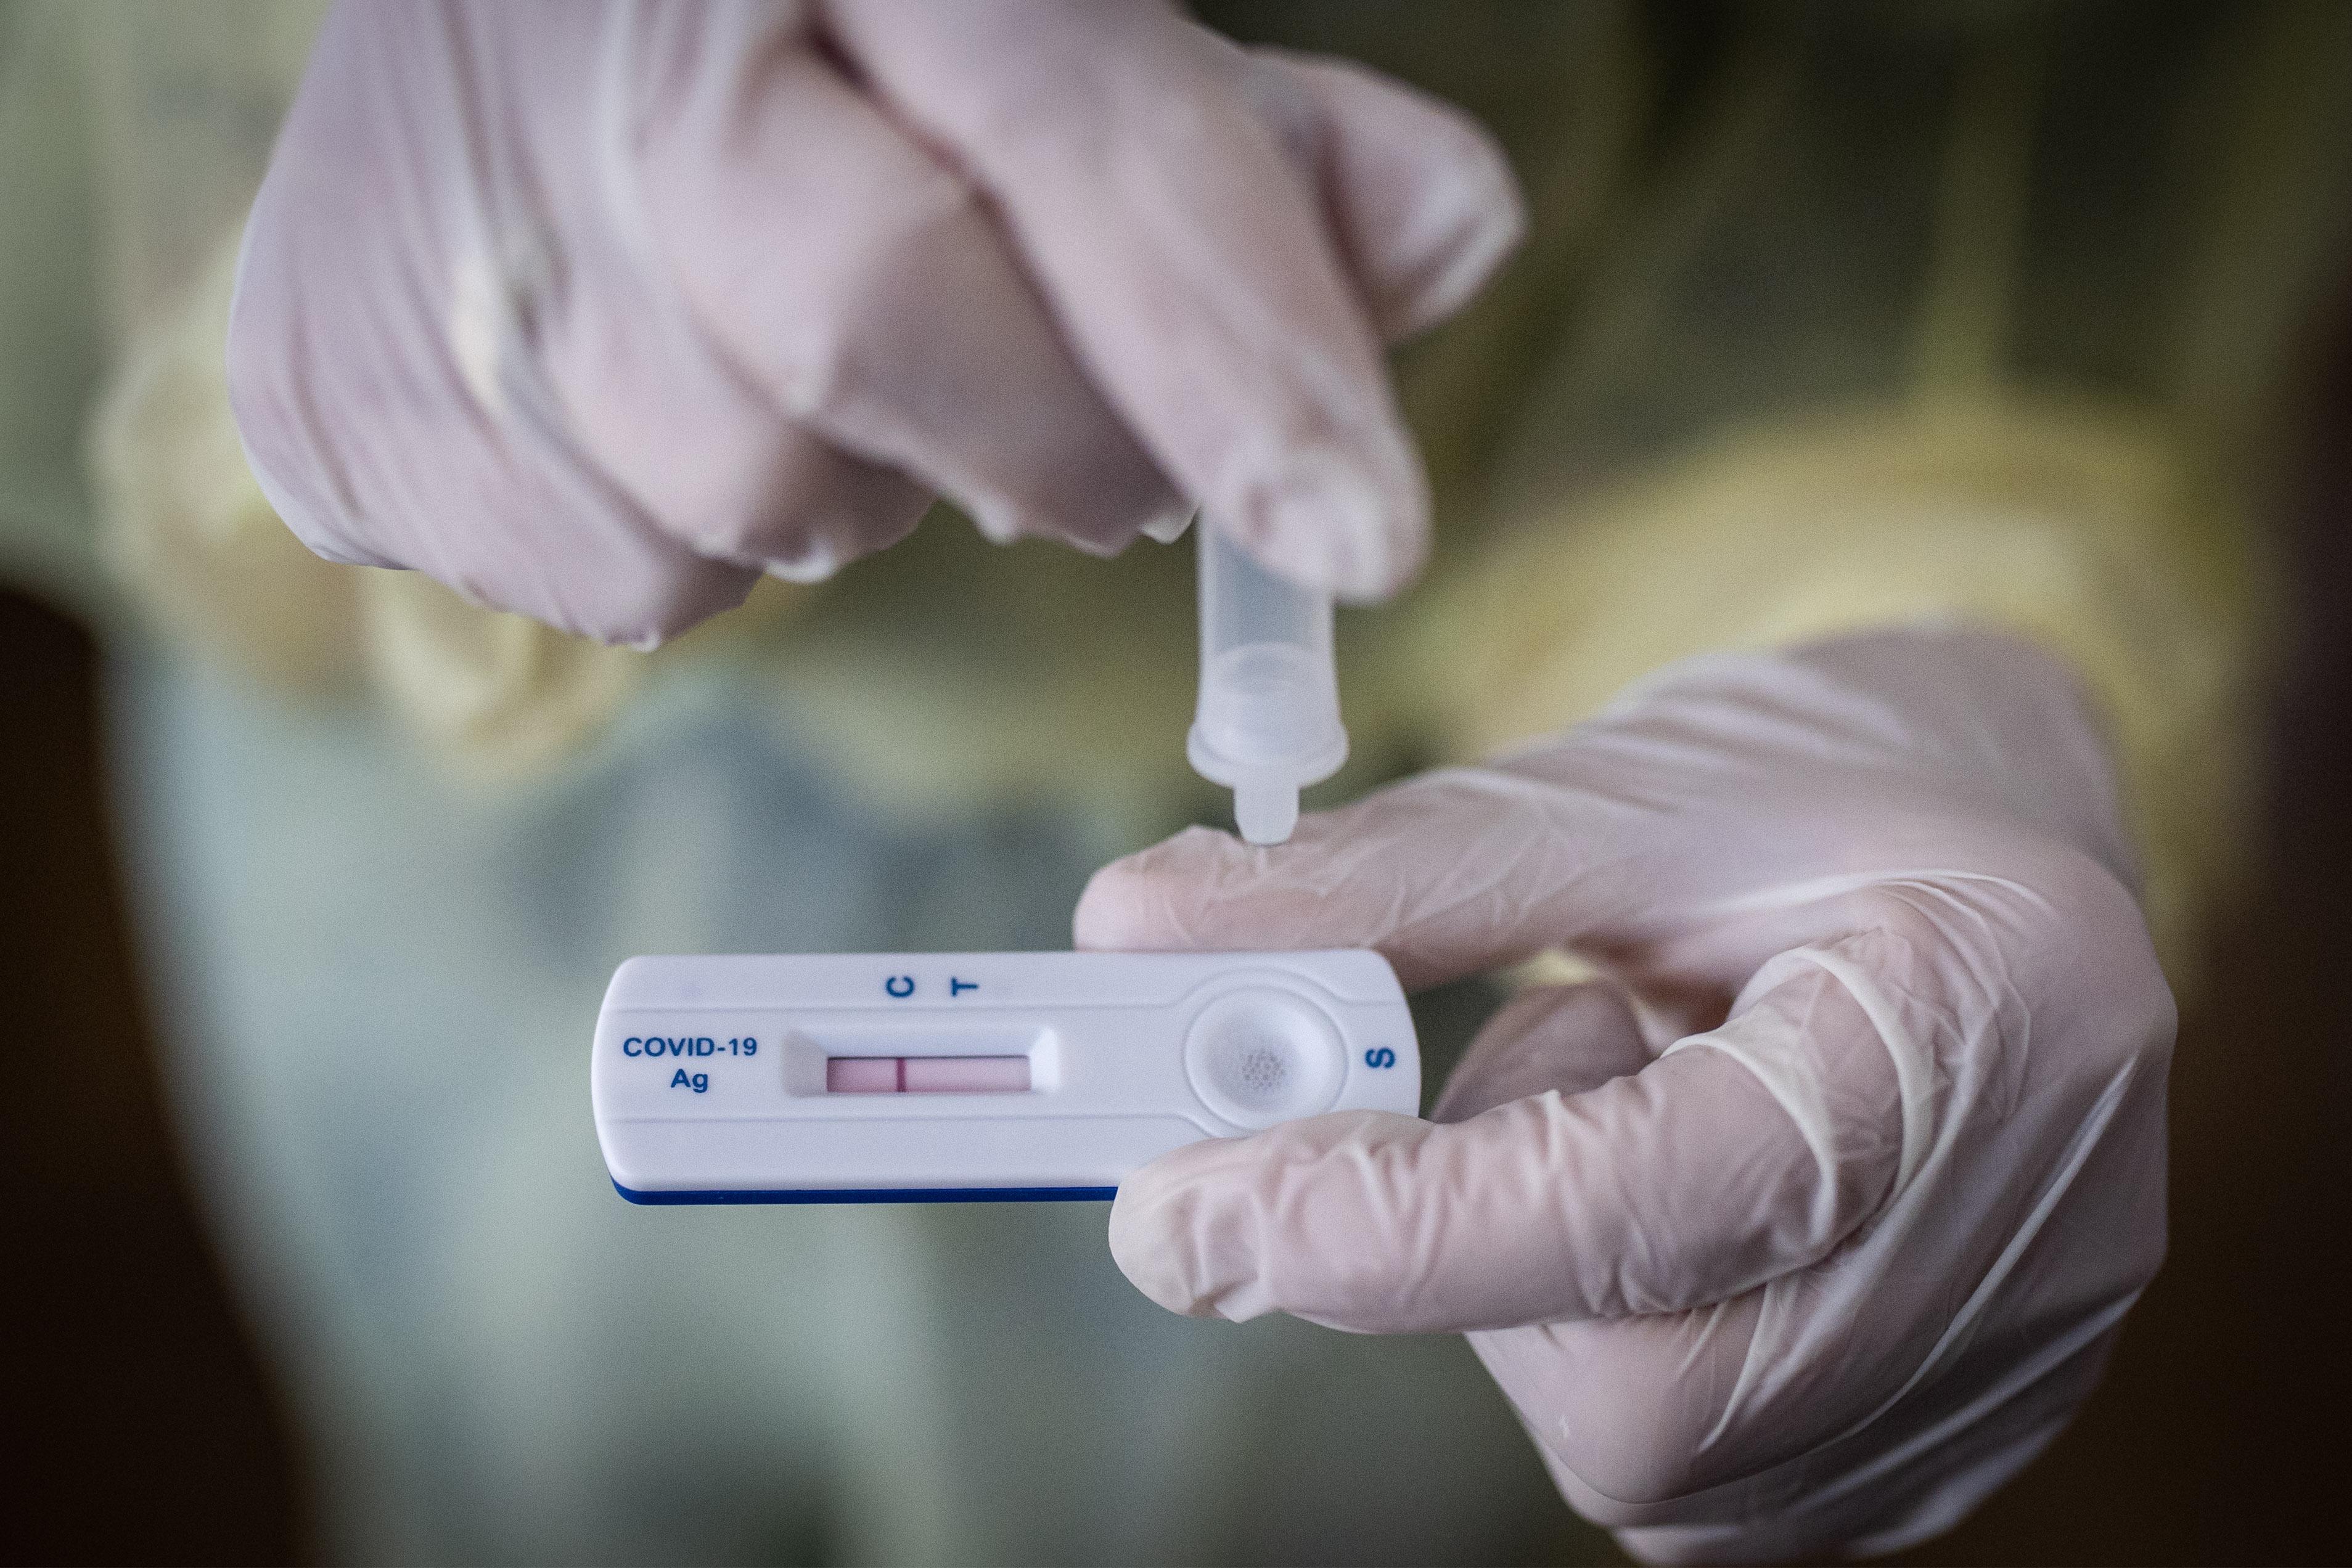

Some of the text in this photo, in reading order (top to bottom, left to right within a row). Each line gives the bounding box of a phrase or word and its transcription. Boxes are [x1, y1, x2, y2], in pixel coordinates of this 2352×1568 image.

[884, 976, 916, 998] C
[950, 976, 979, 997] T
[622, 1036, 758, 1058] COVID-19
[1364, 1047, 1396, 1069] S
[670, 1068, 708, 1093] Ag
